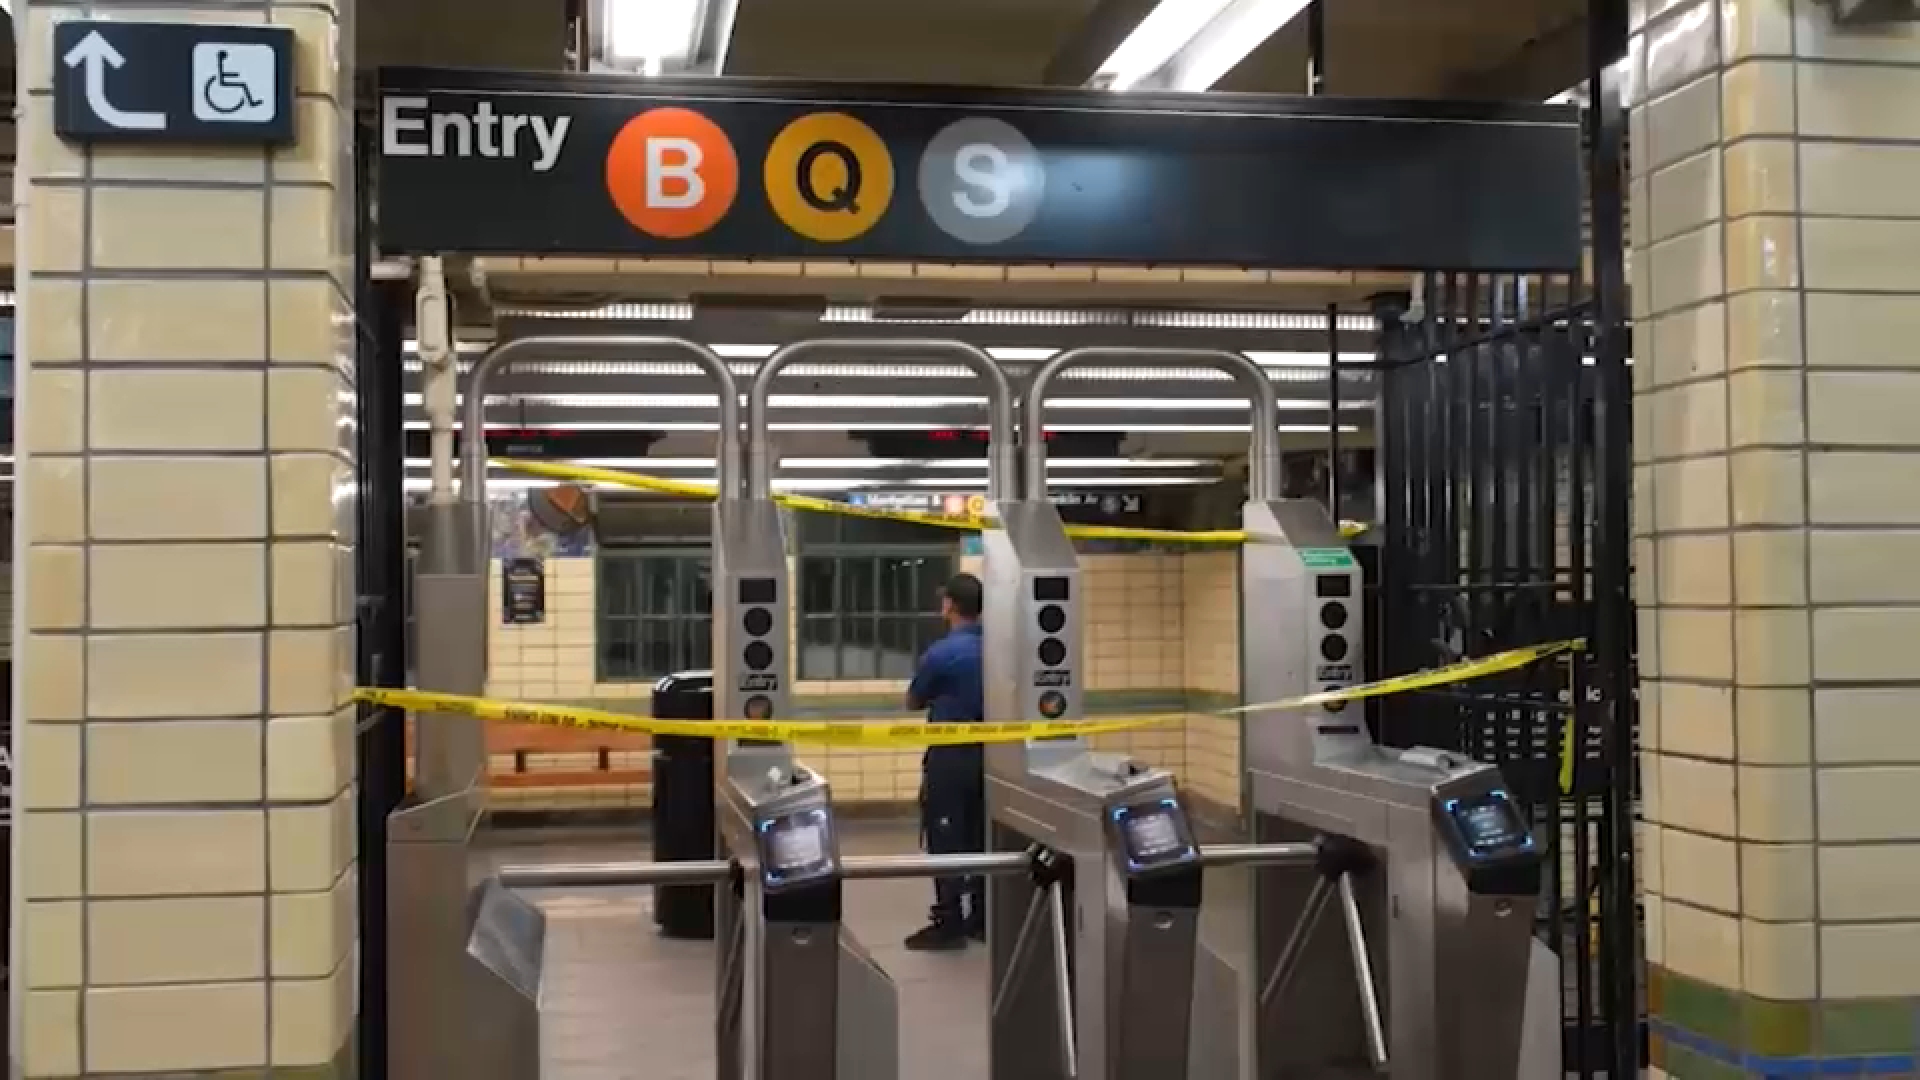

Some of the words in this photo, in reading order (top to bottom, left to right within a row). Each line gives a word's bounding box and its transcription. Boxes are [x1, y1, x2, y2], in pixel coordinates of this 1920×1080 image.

[382, 97, 571, 170] Entry
[645, 137, 705, 208] B
[797, 140, 861, 214] Q
[952, 143, 1014, 217] S
